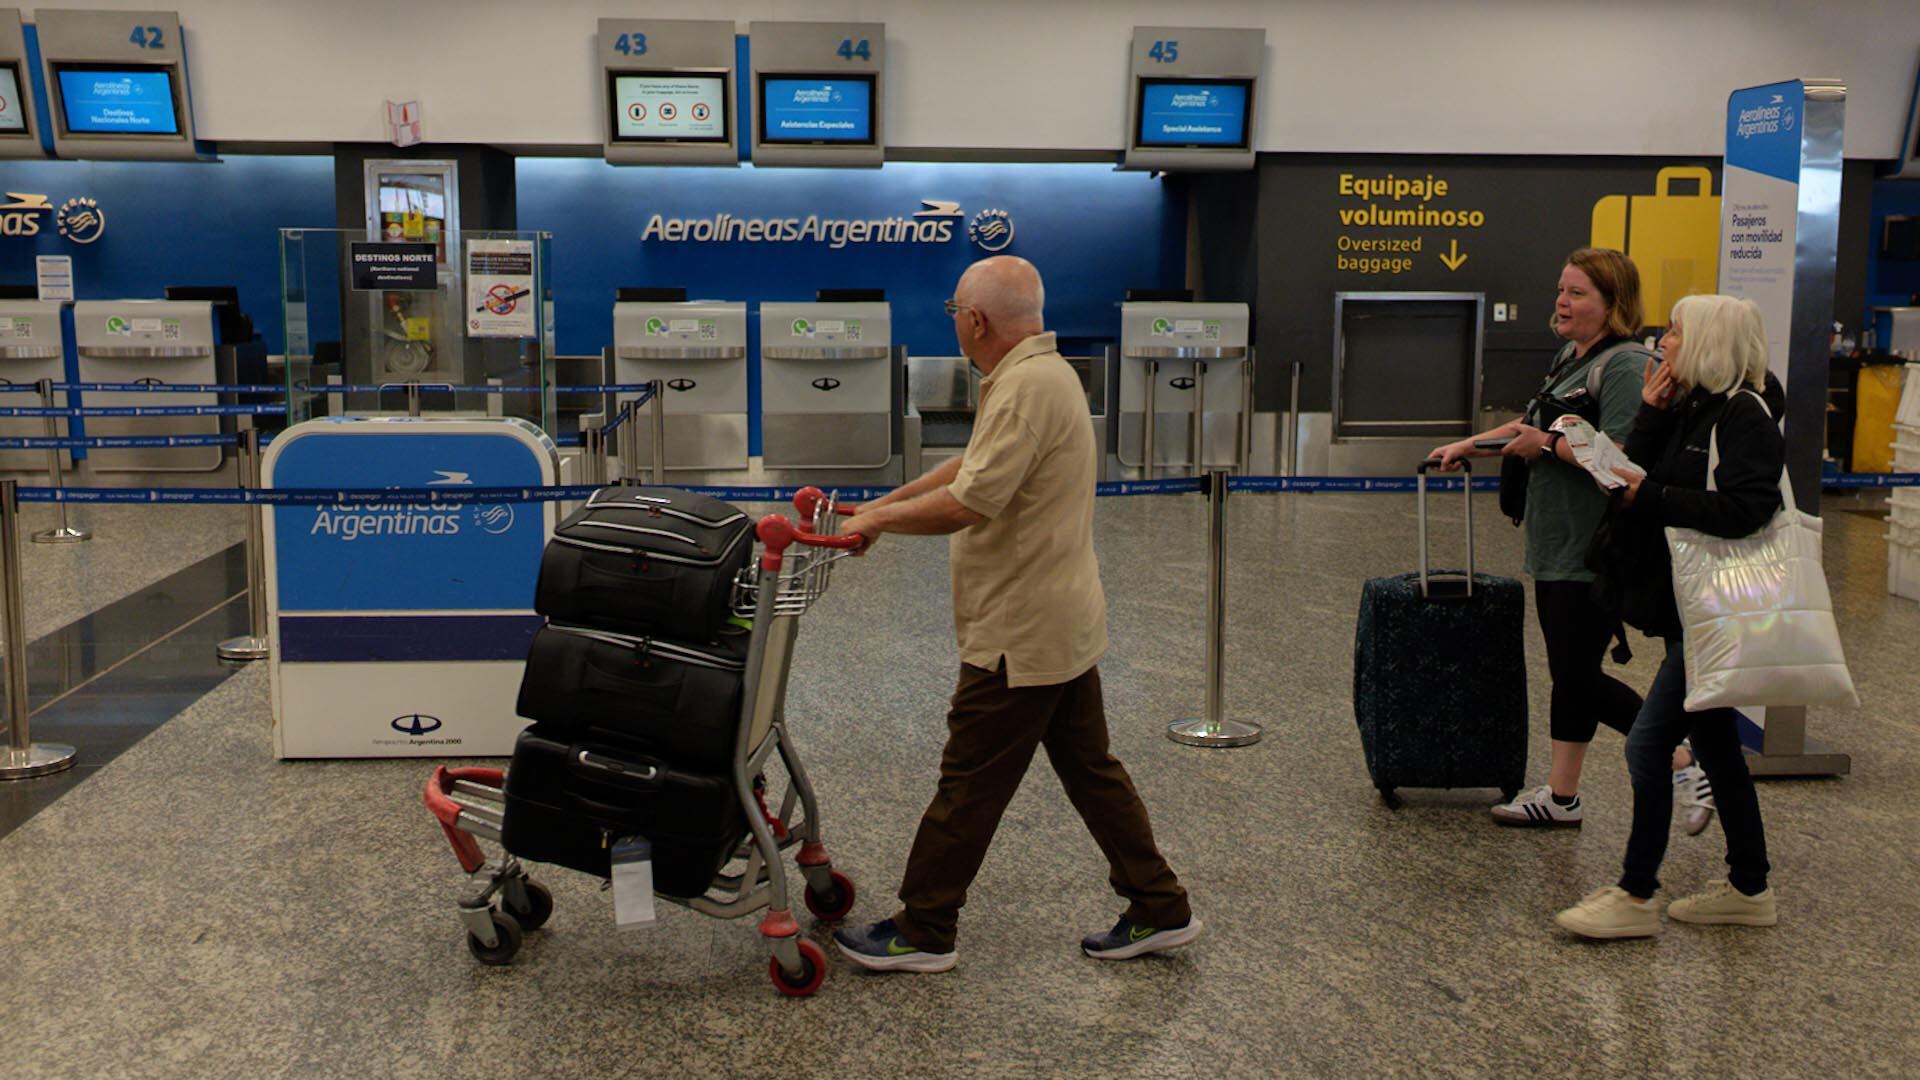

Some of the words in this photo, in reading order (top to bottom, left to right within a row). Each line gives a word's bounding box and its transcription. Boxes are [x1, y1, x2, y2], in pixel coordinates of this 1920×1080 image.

[129, 25, 164, 49] 42
[614, 33, 648, 56] 43
[836, 39, 871, 61] 44
[1149, 40, 1179, 63] 45
[1162, 124, 1187, 134] Special
[1188, 125, 1222, 133] Assistance
[1736, 120, 1778, 139] Argentinas
[1339, 173, 1449, 201] Equipaje
[0, 211, 40, 236] as
[1339, 203, 1485, 227] voluminoso
[1732, 213, 1767, 229] Pasajeros
[1337, 235, 1422, 251] Oversized
[1731, 233, 1744, 243] con
[1745, 229, 1784, 243] movilidad
[354, 253, 401, 262] DESTINOS
[402, 253, 434, 262] NORTE
[1730, 245, 1762, 259] reducida
[1337, 255, 1413, 273] baggage
[310, 511, 461, 540] Argentinas
